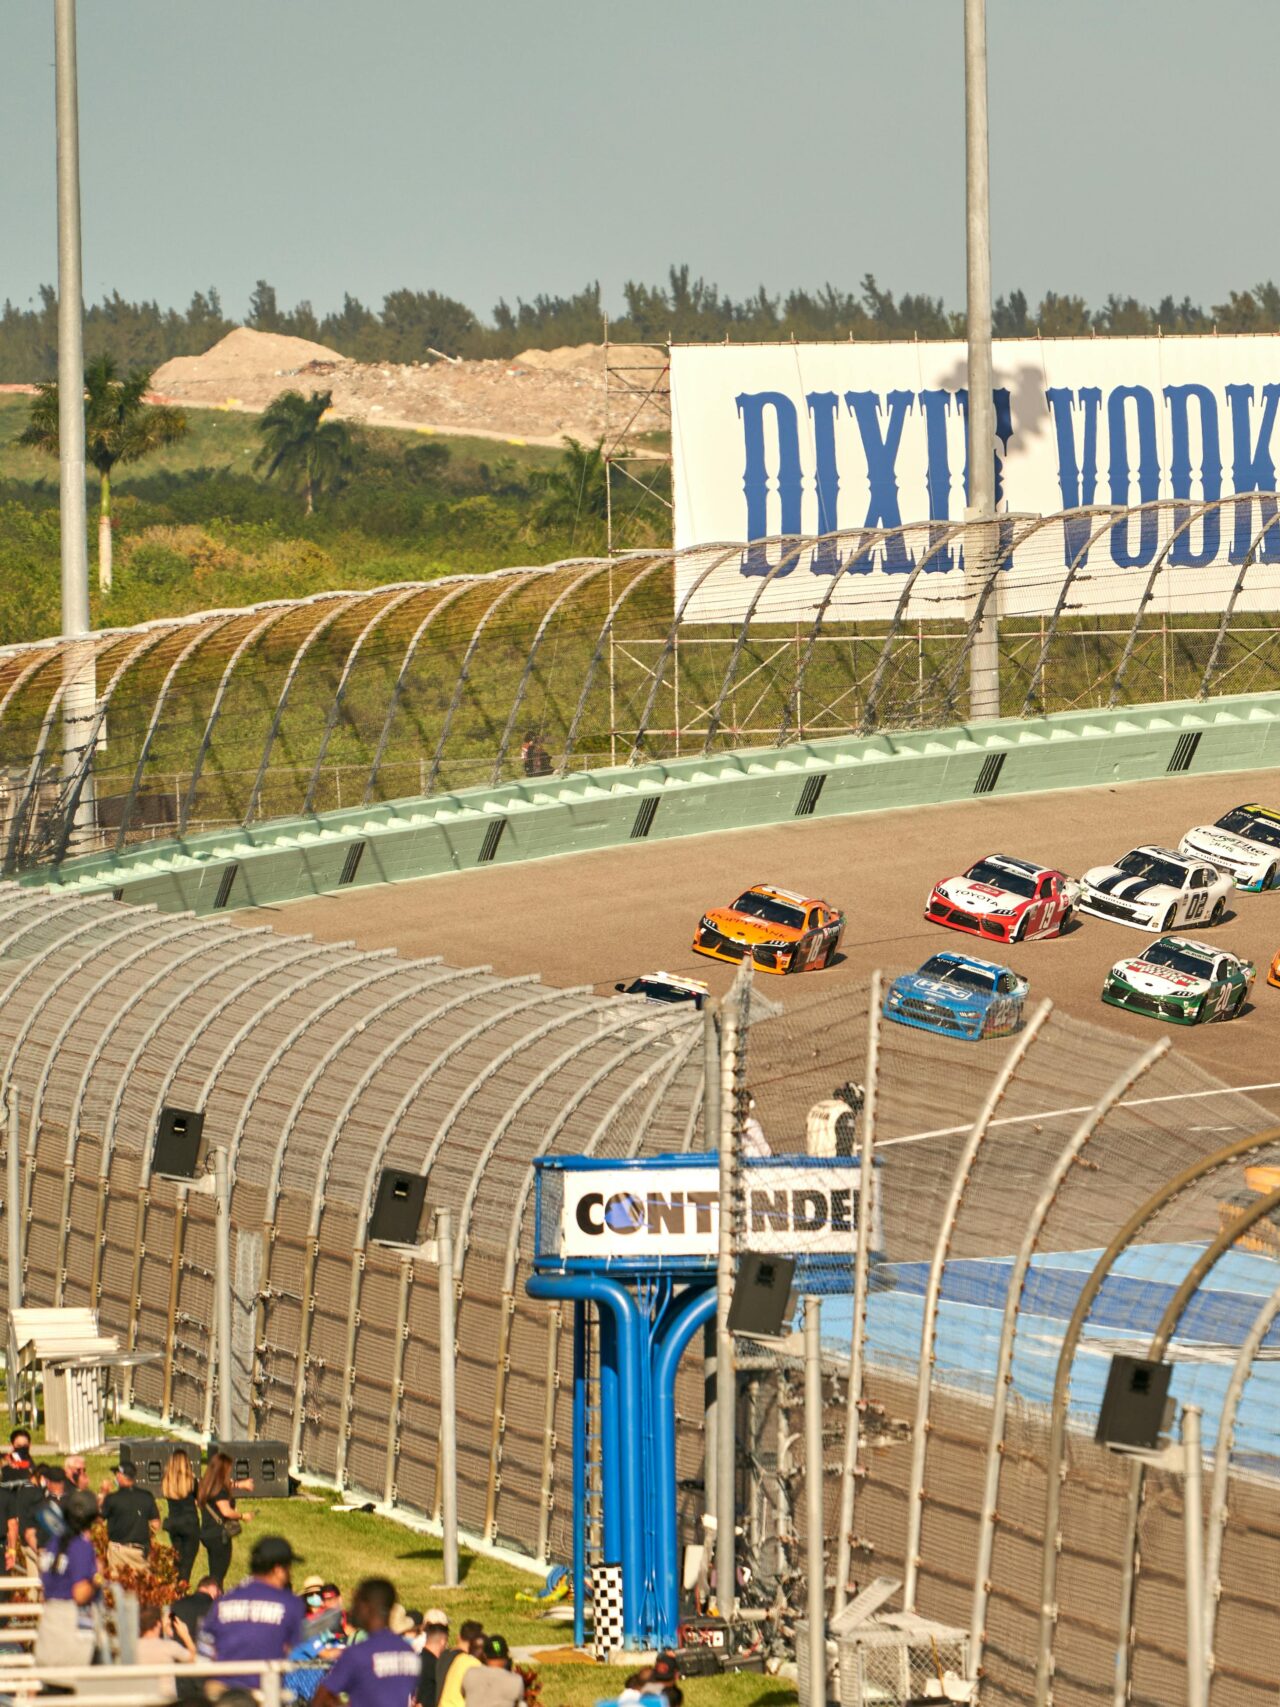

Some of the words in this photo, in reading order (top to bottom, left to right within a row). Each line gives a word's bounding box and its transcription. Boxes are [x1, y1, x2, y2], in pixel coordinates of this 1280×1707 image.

[954, 889, 999, 907] TOYOTA
[1184, 891, 1209, 922] 02
[1039, 901, 1057, 930] 19
[806, 933, 824, 963] 18
[1214, 982, 1233, 1013] 20
[575, 1189, 862, 1236] CONTNDE
